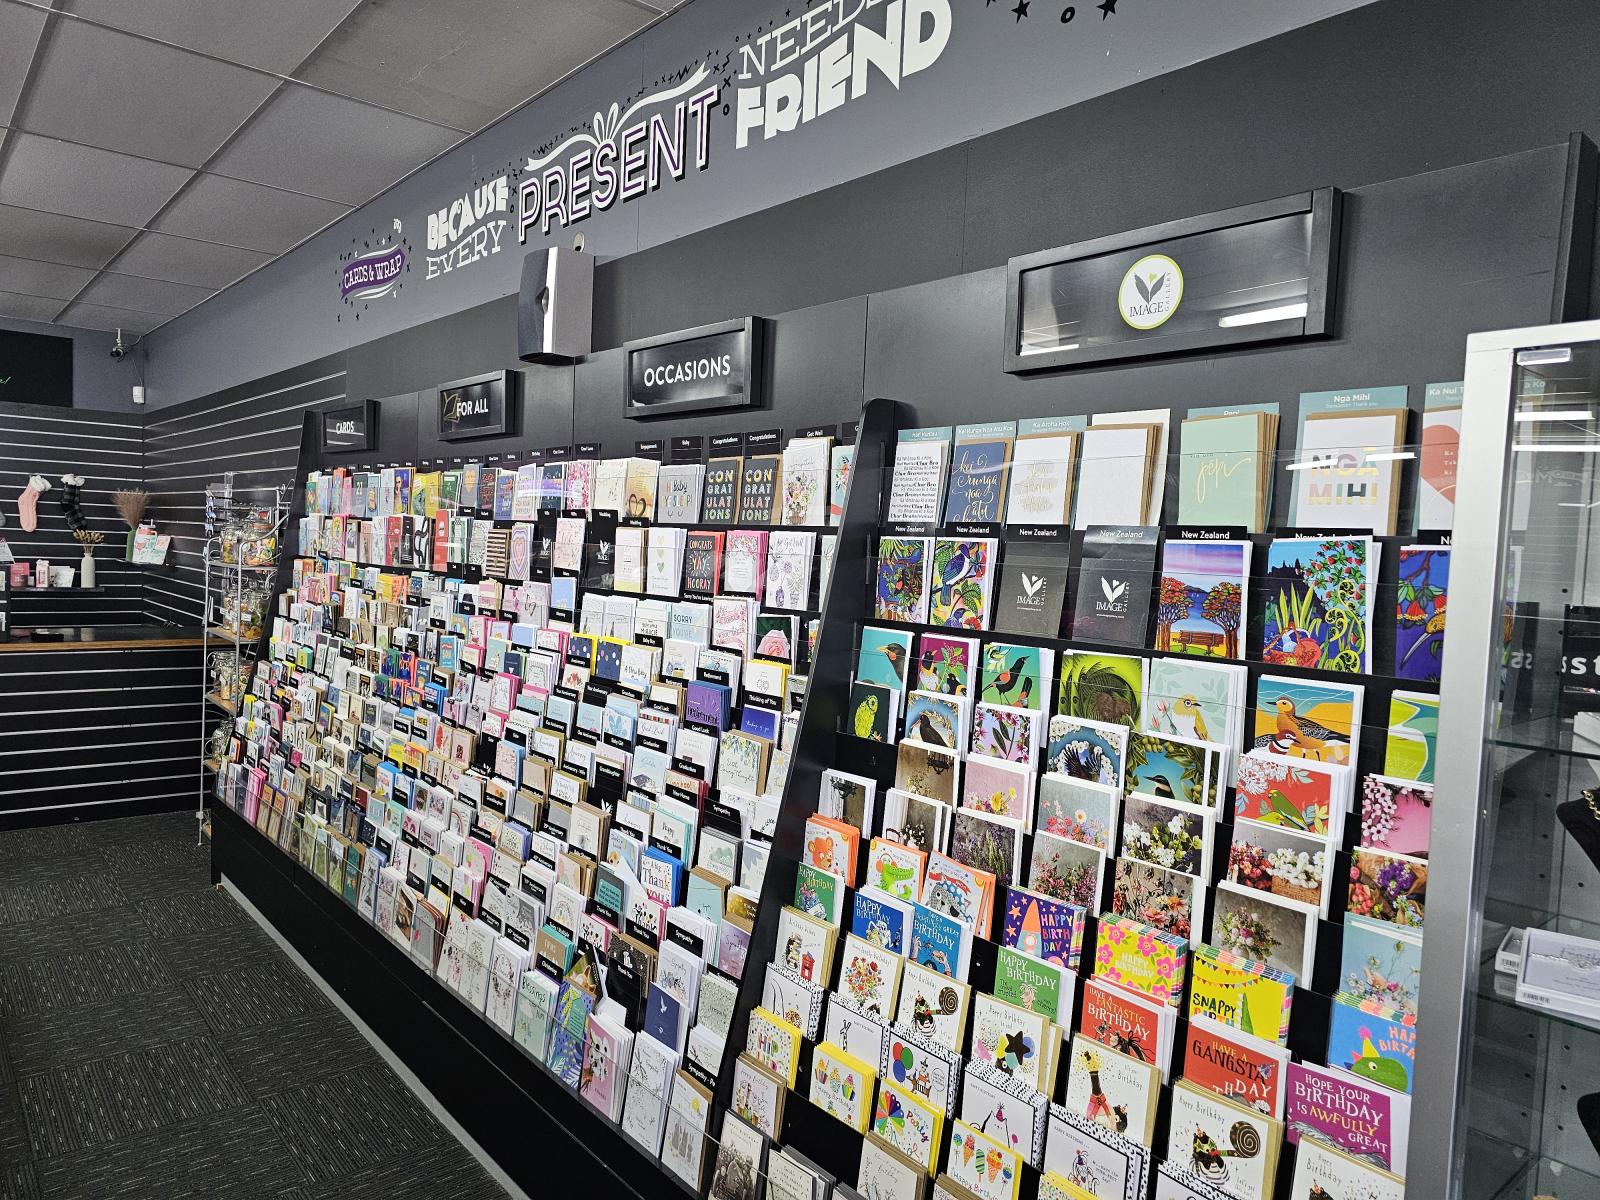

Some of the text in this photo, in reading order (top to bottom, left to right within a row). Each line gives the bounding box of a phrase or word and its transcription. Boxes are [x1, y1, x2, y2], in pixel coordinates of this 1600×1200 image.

[735, 0, 952, 149] FRIEND
[518, 88, 722, 244] PRESENT
[427, 176, 508, 251] BECAUSE
[426, 220, 506, 280] EVERY
[344, 254, 401, 289] CARDS & WRAP
[1130, 301, 1164, 317] IMAGE
[644, 355, 731, 387] OCCASIONS
[1352, 392, 1370, 401] Mihi
[1429, 388, 1441, 396] Ka
[1442, 387, 1457, 395] Nui
[456, 399, 489, 418] FOR ALL
[336, 420, 354, 435] CARDS
[708, 469, 734, 483] CON
[746, 468, 772, 483] CON
[707, 483, 733, 495] GRAT
[744, 483, 772, 495] GRAT
[1308, 482, 1378, 506] MIHI
[706, 495, 732, 508] ULAT
[743, 496, 771, 509] ULAT
[705, 508, 731, 520] IONS
[742, 509, 769, 521] IONS
[968, 526, 990, 535] Zealand
[1019, 528, 1057, 537] New Zealand
[1099, 529, 1143, 539] New Zealand
[1181, 530, 1230, 540] New Zealand
[689, 539, 713, 550] CONGRATS
[692, 556, 707, 570] YAY
[687, 576, 712, 590] HOORAY
[1016, 595, 1041, 606] IMAGE
[1096, 601, 1123, 612] IMAGE
[673, 614, 693, 624] SORRY
[691, 724, 710, 734] Good Luck
[712, 804, 731, 817] Sympathy
[656, 841, 673, 854] Thank You
[642, 866, 669, 891] Thank
[799, 865, 817, 878] HAPPY
[856, 895, 882, 916] HAPPY
[856, 908, 891, 924] BIRTHDAY
[1041, 913, 1074, 927] HAPPY
[913, 920, 955, 950] BIRTHDAY
[1042, 928, 1071, 940] BIRTH
[1043, 941, 1062, 953] DAY
[1000, 950, 1028, 971] HAPPY
[1121, 951, 1149, 969] HAPPY
[1114, 959, 1155, 979] BIRTHDAY
[1006, 966, 1057, 990] BIRTHDAY
[522, 975, 546, 1003] Blessings
[1088, 986, 1113, 1003] HAVE A
[1096, 996, 1146, 1024] FANTASTIC
[1192, 991, 1237, 1019] SNAPPY
[1087, 1003, 1151, 1041] BIRTHDAY
[1212, 1040, 1247, 1062] HAVE A
[1192, 1039, 1266, 1085] GANGSTA
[688, 1063, 708, 1082] Sympathy
[1212, 1078, 1272, 1098] THDAY
[1305, 1073, 1372, 1105] HOPE YOUR
[1295, 1080, 1383, 1127] BIRTHDAY
[1195, 1101, 1225, 1124] Birthday
[1296, 1101, 1378, 1137] IS AWFULLY
[1348, 1132, 1388, 1154] GREAT
[1306, 1157, 1342, 1186] Birthday
